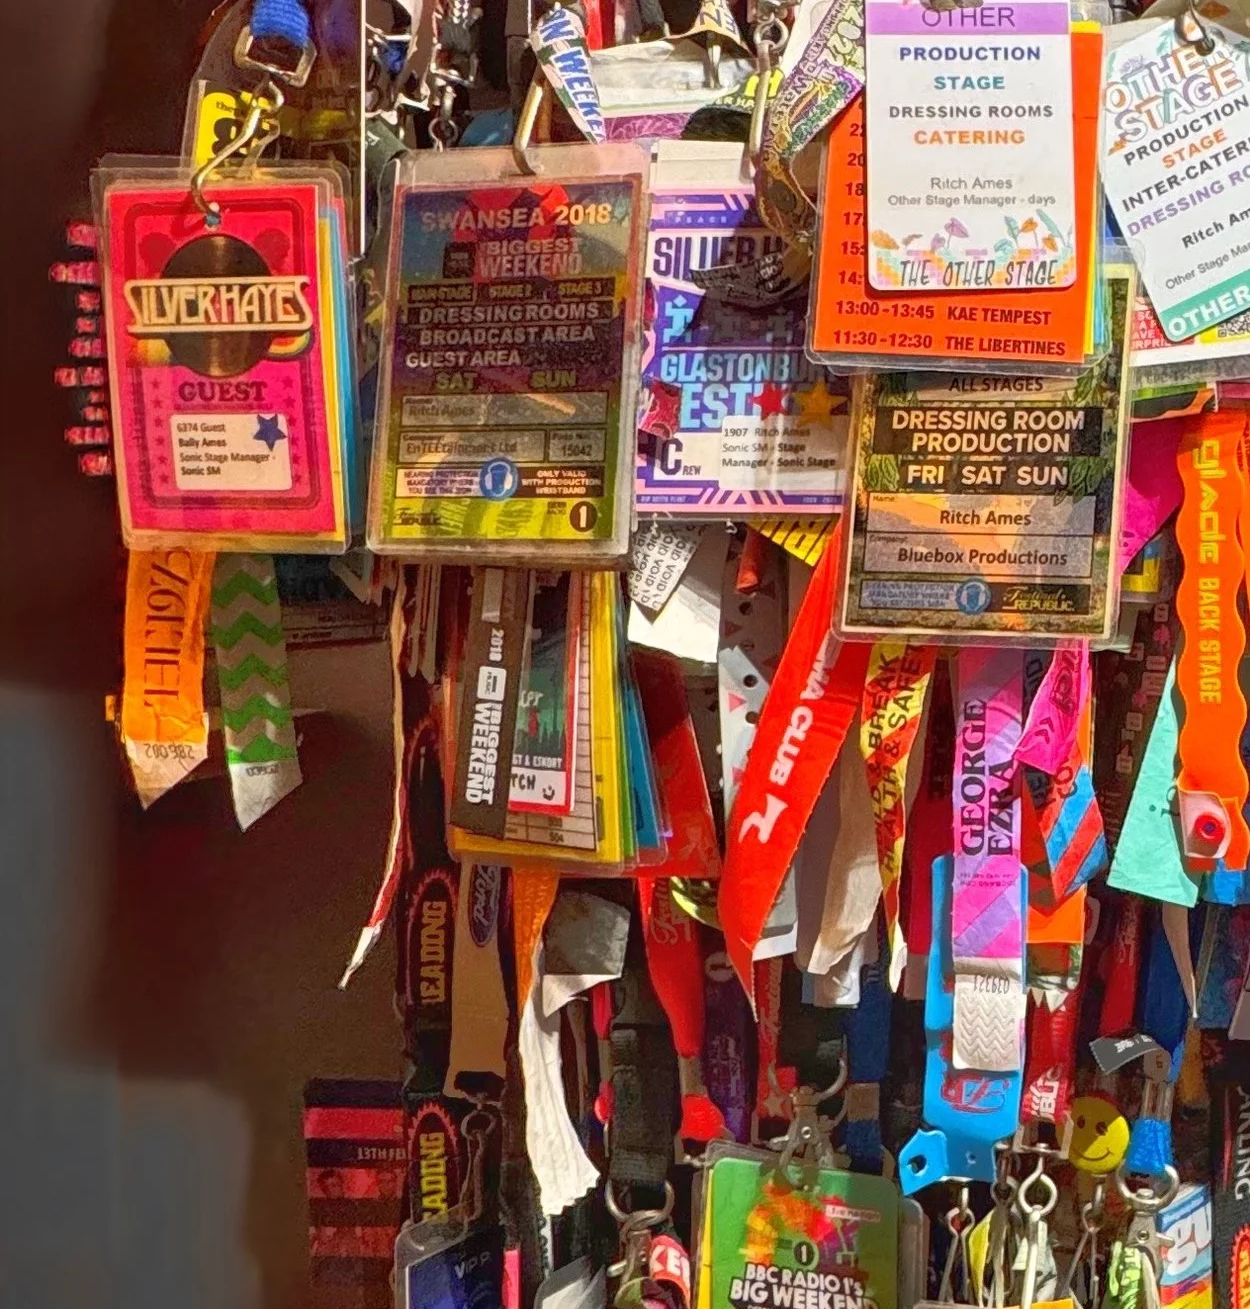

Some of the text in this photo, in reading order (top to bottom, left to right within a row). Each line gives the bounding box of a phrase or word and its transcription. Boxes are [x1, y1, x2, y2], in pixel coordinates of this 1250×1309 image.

[922, 6, 1015, 28] OTHER
[900, 47, 1040, 61] PRODUCTION
[934, 76, 1004, 90] STAGE
[889, 105, 1053, 119] DRESSING ROOMS
[914, 131, 1025, 145] CATERING
[1125, 95, 1250, 166] PRODUCTION
[1162, 128, 1227, 169] STAGE
[931, 177, 1012, 190] Ritch Ames
[421, 205, 611, 230] SWANSEA 2018
[902, 260, 1058, 286] THE OTHER STAGE
[125, 278, 313, 332] SILVERHAYES
[419, 303, 599, 324] DRESSING ROOMS
[948, 306, 979, 321] KAE
[984, 308, 1051, 325] TEMPEST
[420, 326, 595, 346] BROADCAST AREA
[946, 337, 974, 350] THE
[979, 337, 1066, 356] LIBERTINES
[436, 371, 576, 390] SAT SUN
[949, 377, 1043, 392] ALL STAGES
[179, 381, 266, 402] GUEST
[893, 410, 1084, 430] DRESSING ROOM
[912, 434, 1070, 452] PRODUCTION
[908, 467, 1068, 485] FRI SAT SUN
[940, 511, 1031, 526] Ritch Ames
[899, 548, 1067, 564] Bluebox Productions
[1198, 576, 1220, 626] BACK
[1200, 632, 1221, 705] STAGE
[960, 699, 987, 857] GEORGE
[988, 761, 1015, 857] EZRA
[731, 1276, 769, 1303] BIG
